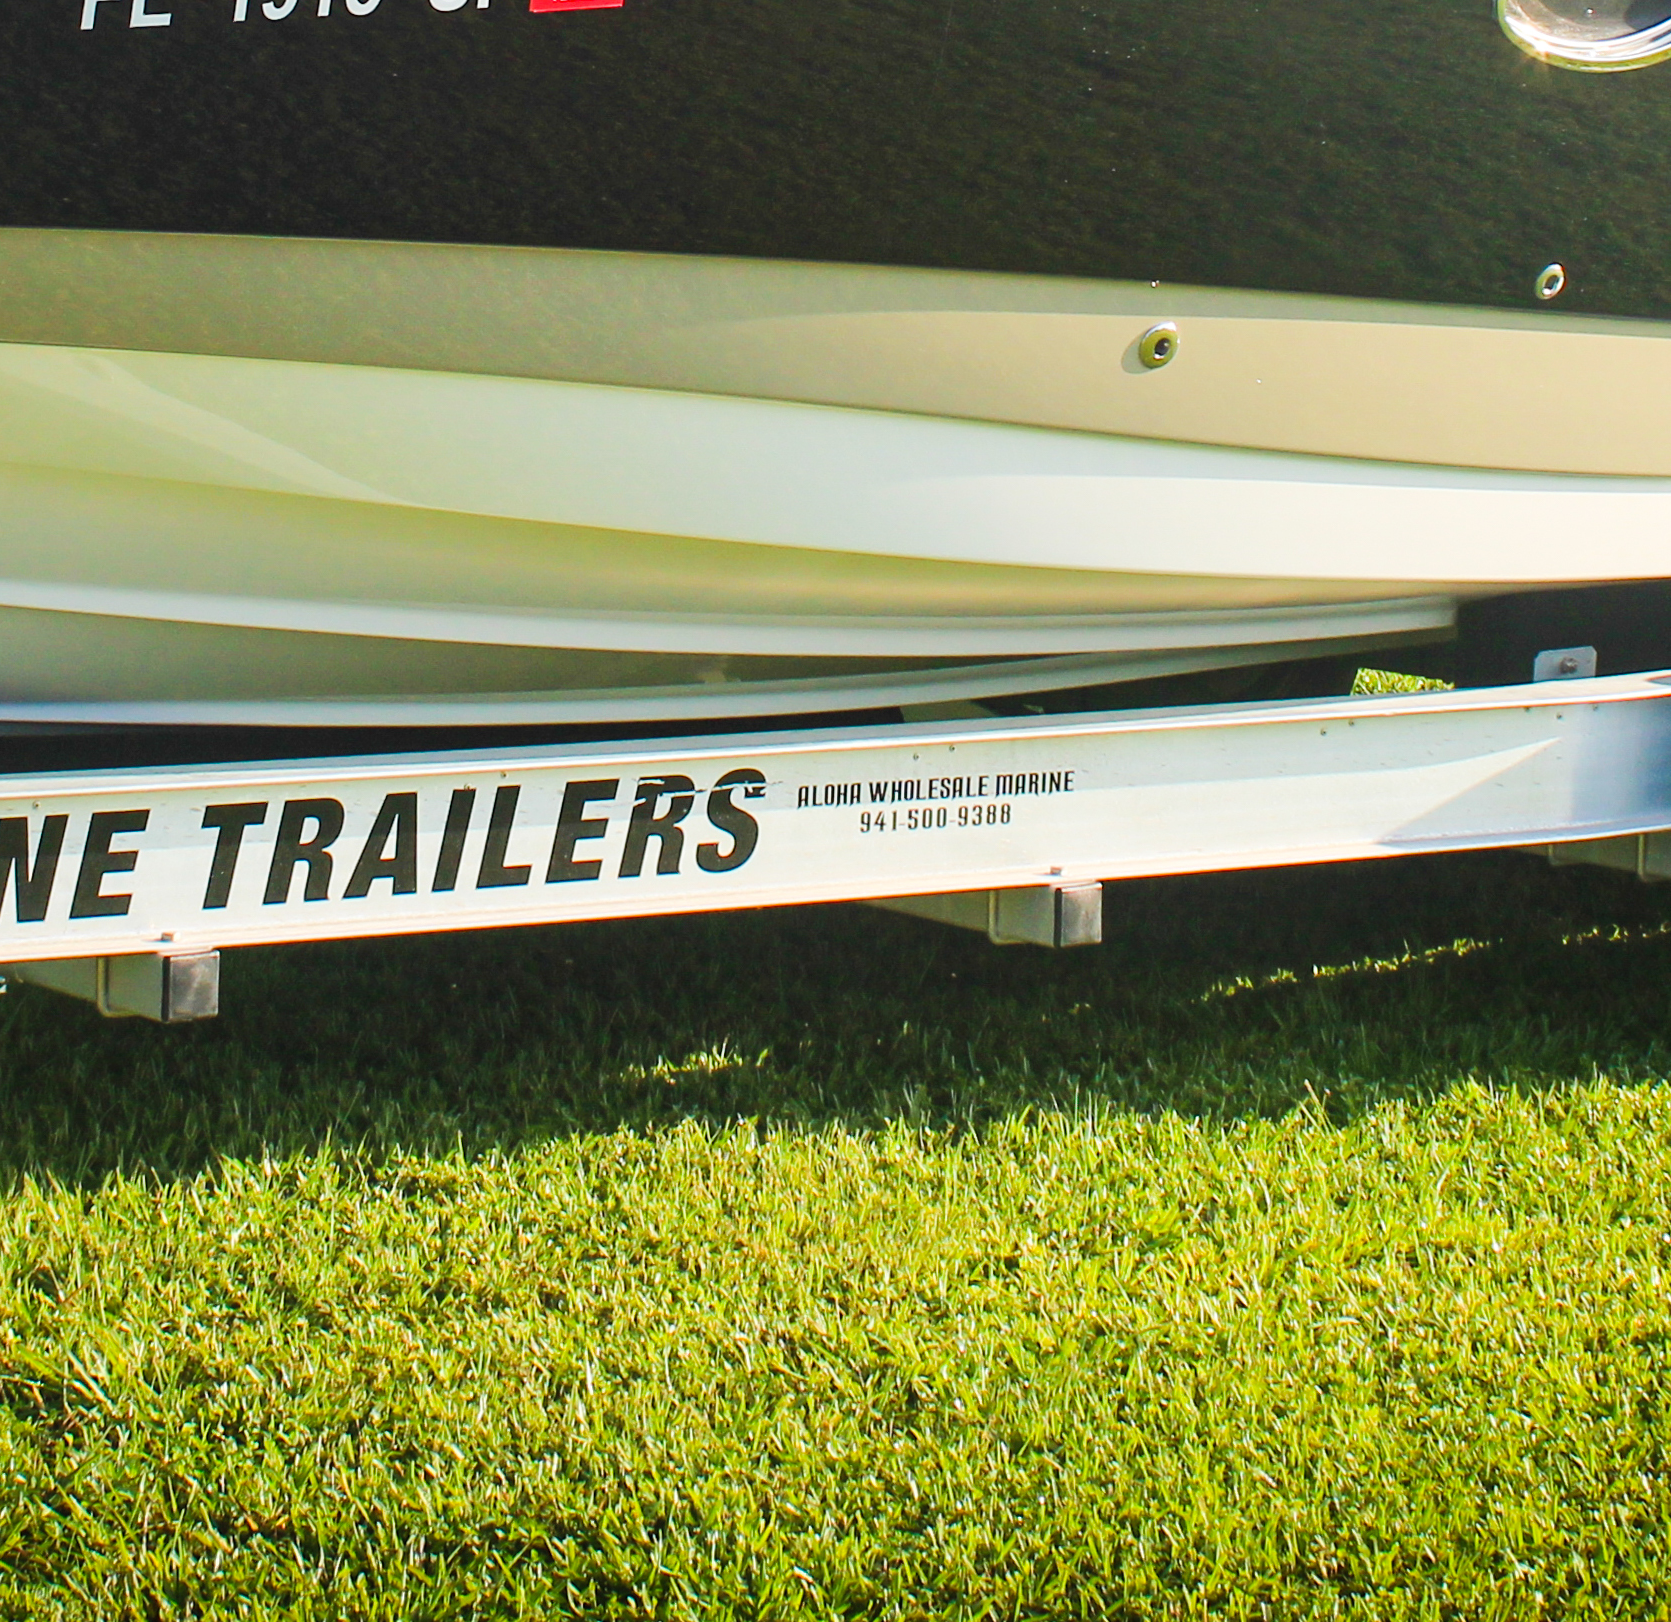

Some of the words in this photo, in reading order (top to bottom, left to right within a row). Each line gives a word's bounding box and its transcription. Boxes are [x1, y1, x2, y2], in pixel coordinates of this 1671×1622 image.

[796, 782, 863, 809] ALOHA
[868, 775, 989, 804] WHOLESALE
[994, 770, 1076, 798] MARINE
[860, 803, 1012, 833] 941-500-9388
[200, 767, 767, 911] TRAILERS
